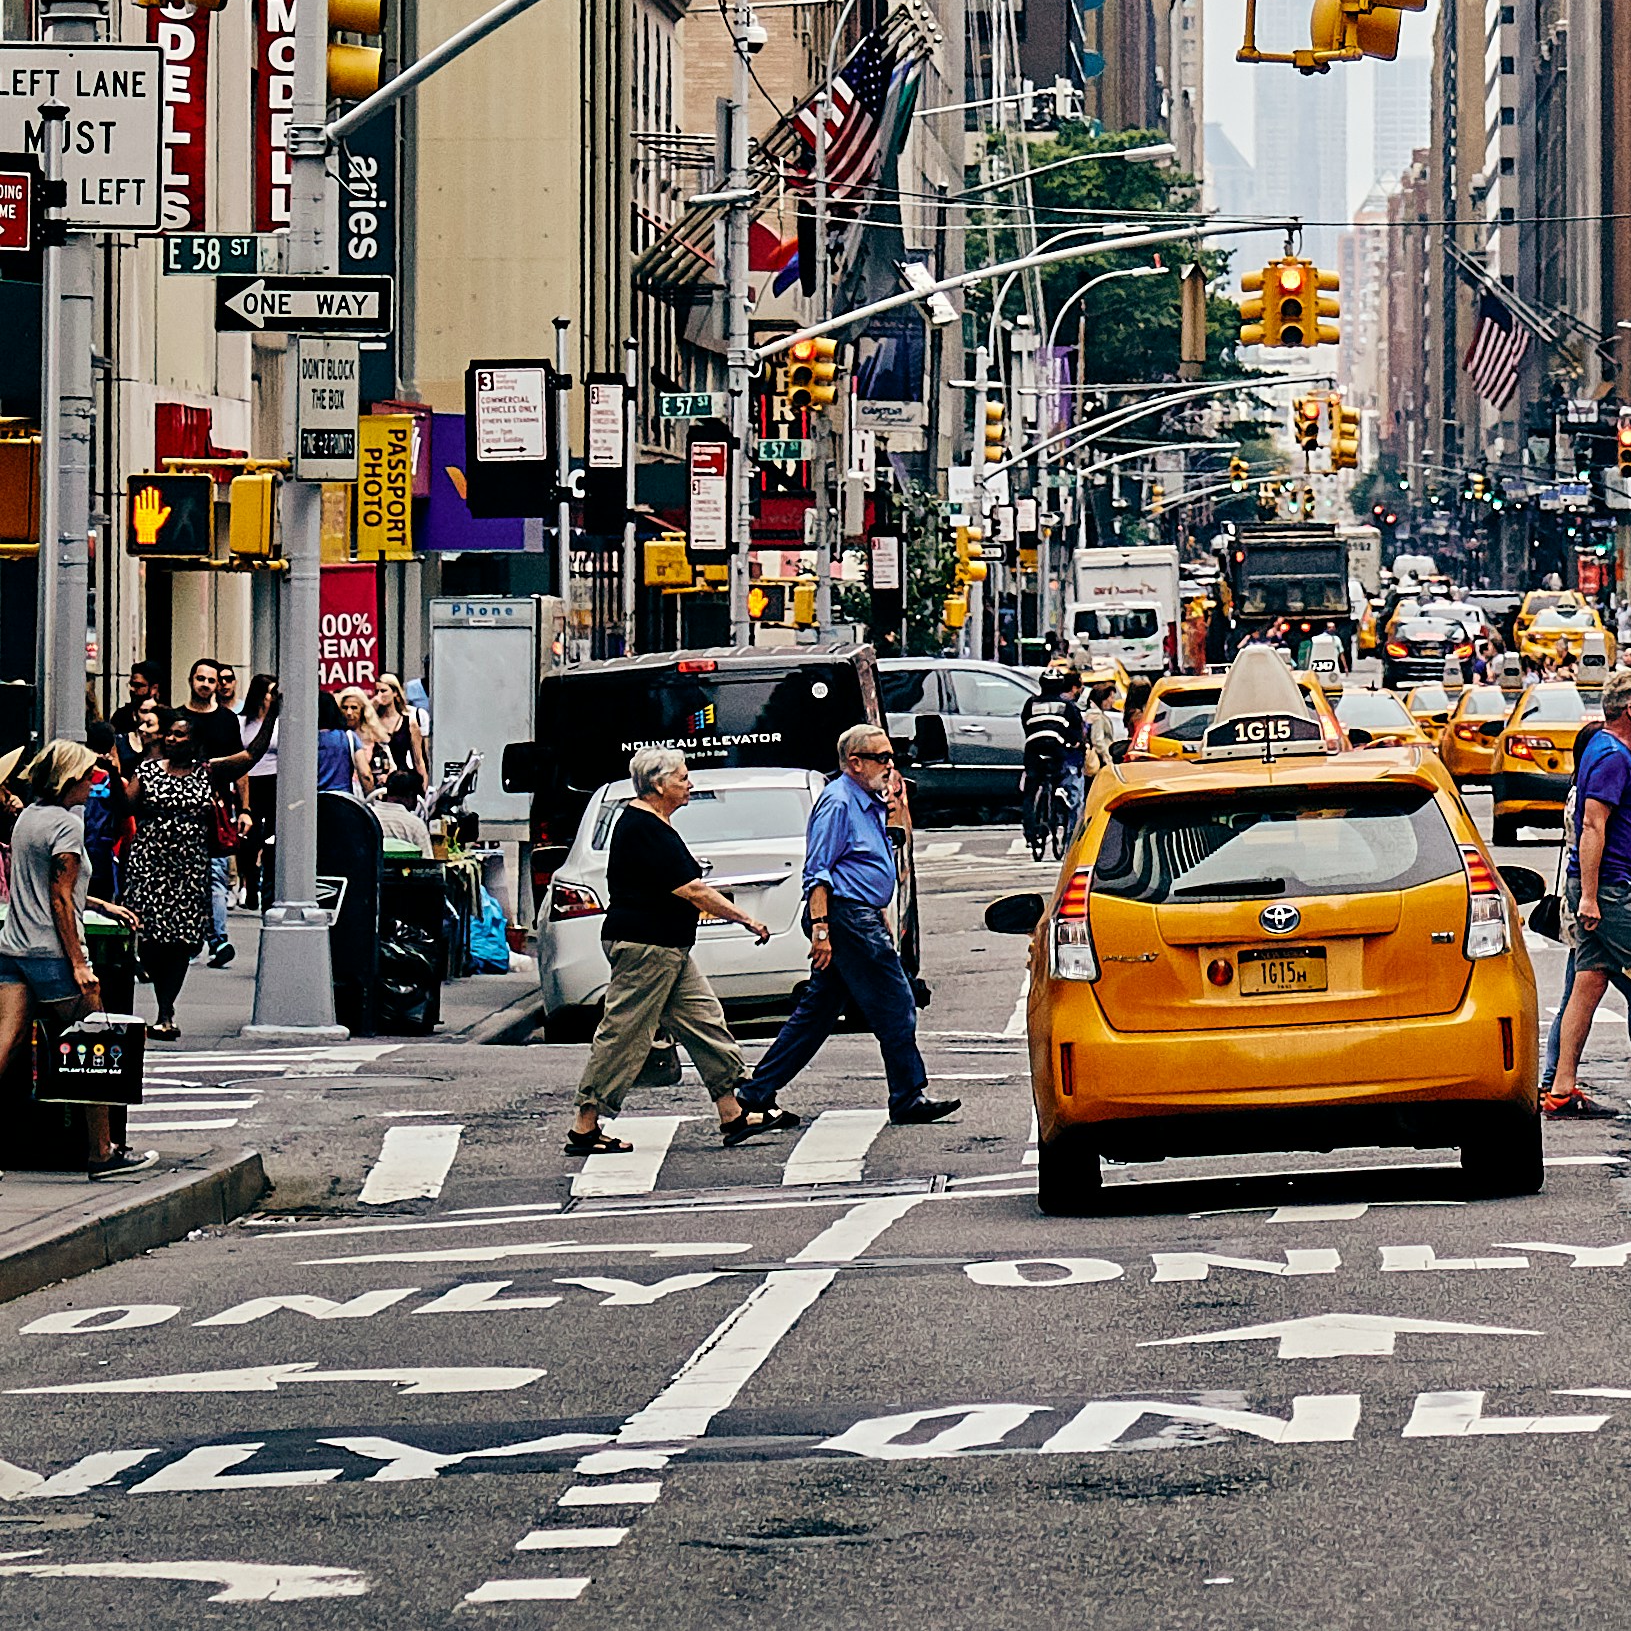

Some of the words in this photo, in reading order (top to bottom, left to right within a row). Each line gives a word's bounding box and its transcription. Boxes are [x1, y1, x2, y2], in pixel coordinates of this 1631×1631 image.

[76, 70, 146, 98] LANE
[81, 178, 146, 206] LEFT
[169, 239, 182, 270] E
[192, 238, 221, 271] 58
[230, 238, 251, 256] ST
[243, 293, 292, 315] ONE
[316, 294, 369, 316] WAY
[327, 359, 355, 381] BLOCK
[480, 372, 492, 391] 3
[311, 389, 327, 410] THE
[328, 388, 345, 410] BOX
[481, 396, 530, 404] COMMERCIAL
[481, 405, 517, 413] VEHICLES
[518, 405, 538, 413] ONLY
[662, 398, 670, 414] E
[676, 397, 693, 414] 57
[771, 441, 785, 457] 57
[363, 447, 383, 527] PHOTO
[386, 428, 407, 546] PASSPORT
[451, 602, 514, 616] Phone
[319, 612, 373, 638] 00%
[621, 738, 698, 752] NOUVEAU
[701, 732, 782, 747] ELEVATOR
[1234, 720, 1291, 742] 1G15
[16, 1269, 750, 1335] ONLY
